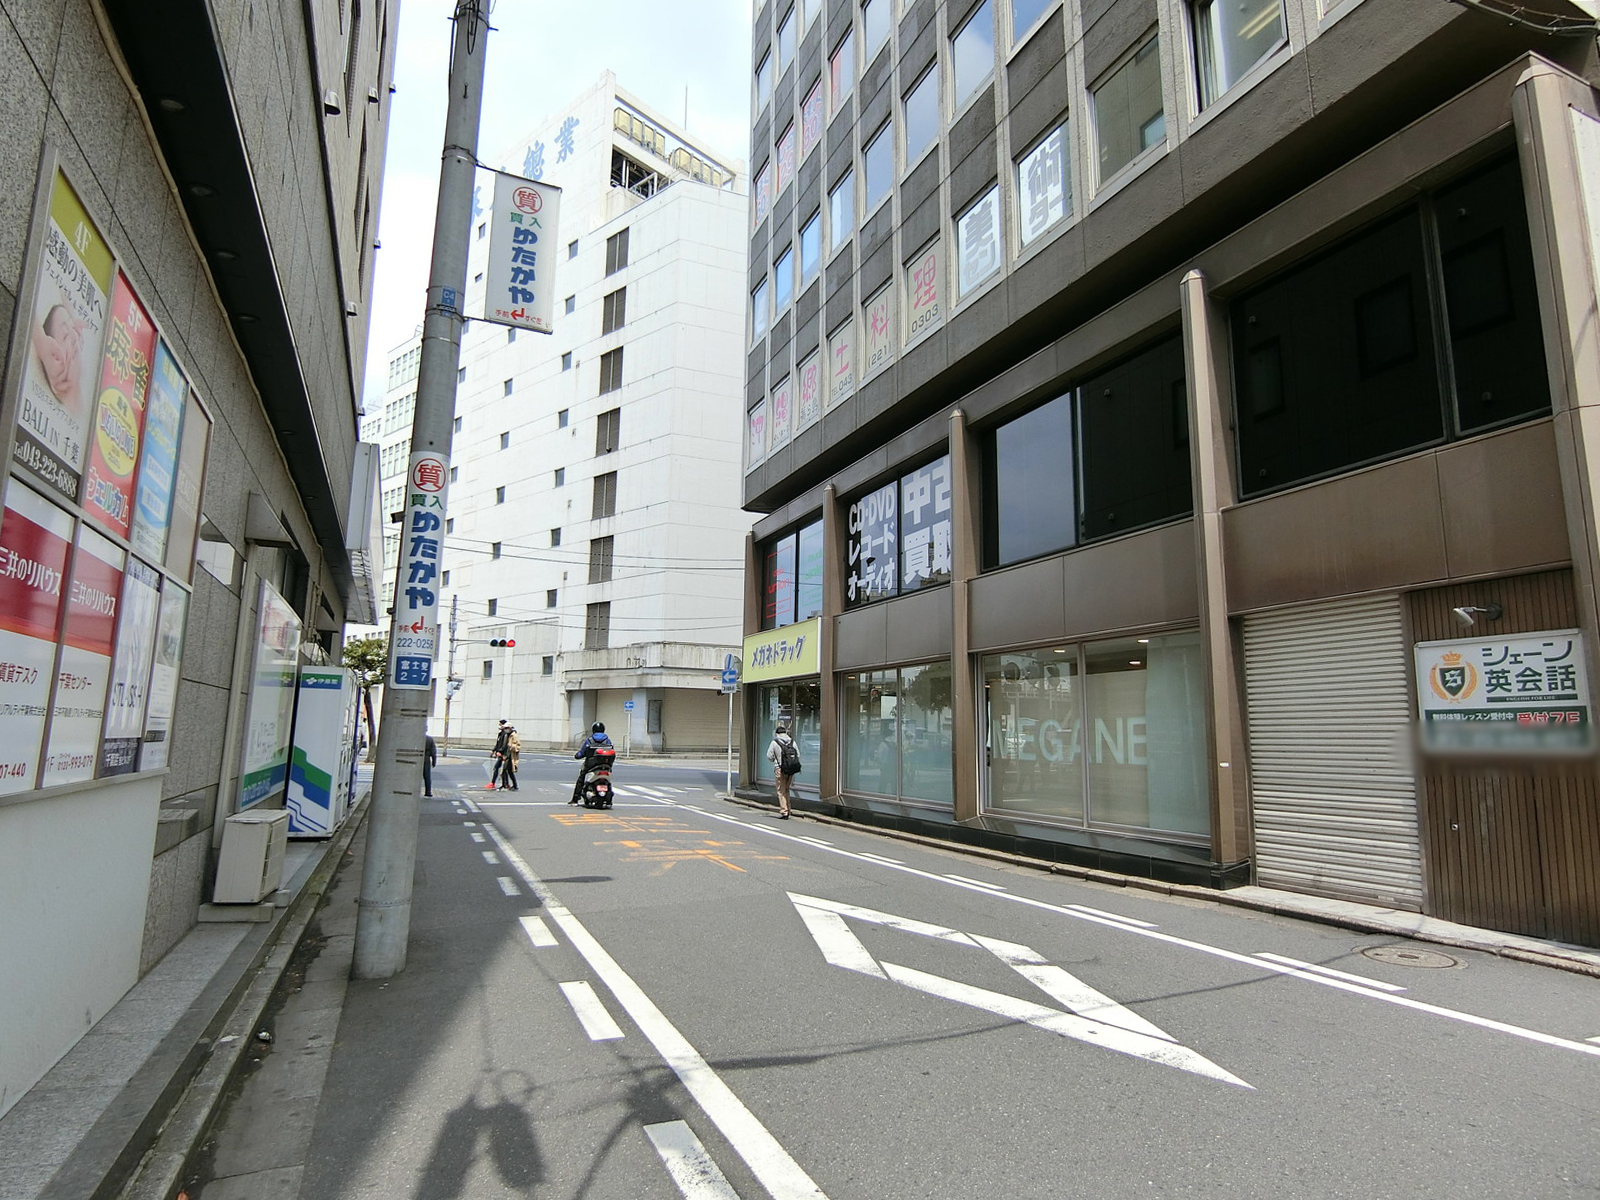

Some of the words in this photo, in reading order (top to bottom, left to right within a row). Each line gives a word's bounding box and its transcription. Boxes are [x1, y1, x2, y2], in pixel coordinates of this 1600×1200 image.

[517, 191, 539, 213] 質
[74, 220, 92, 256] 4F
[510, 212, 542, 229] 買入
[46, 227, 103, 319] 感動の美肌へ
[508, 226, 538, 304] ゆたかや
[128, 301, 142, 333] 5F
[912, 306, 939, 333] 0303
[106, 315, 149, 411] 麻雀
[22, 396, 50, 438] BALI
[49, 428, 60, 447] IN
[63, 435, 80, 465] 千葉
[417, 463, 442, 490] 質
[410, 494, 443, 510] 買入
[405, 511, 440, 609] ゆたかや
[849, 522, 895, 566] レコード
[0, 548, 60, 596] 三井のリハウス
[848, 558, 895, 601] オーディオ
[70, 580, 116, 618] 三井のリハウス
[397, 638, 433, 650] 222-0258
[751, 634, 806, 669] メガネドラッグ
[1481, 640, 1573, 667] シェーン
[59, 672, 92, 692] 千葉センター
[401, 660, 429, 671] 富士見
[1484, 664, 1577, 694] 英会話
[992, 715, 1148, 766] MEGANE
